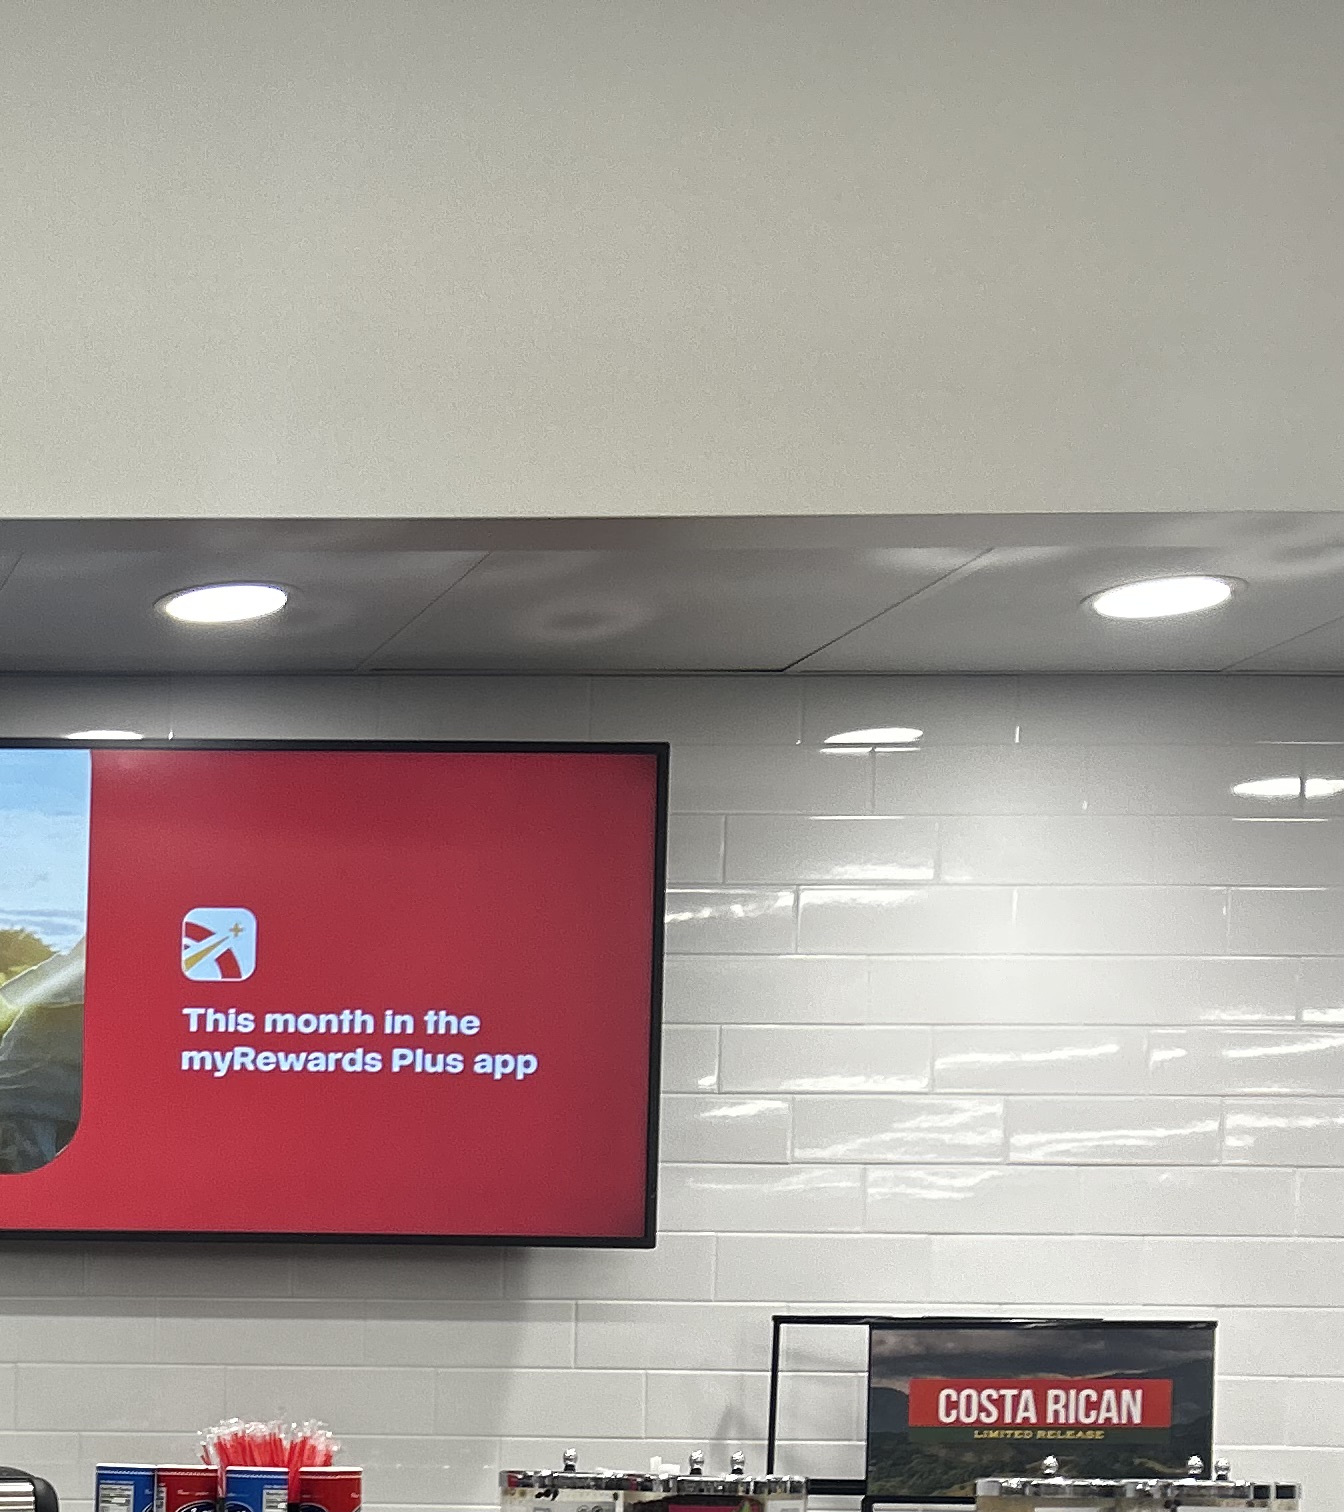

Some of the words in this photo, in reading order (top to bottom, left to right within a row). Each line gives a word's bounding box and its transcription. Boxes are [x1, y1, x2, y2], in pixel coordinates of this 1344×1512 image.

[182, 1007, 255, 1034] This
[265, 1008, 374, 1035] month
[384, 1009, 414, 1035] in
[424, 1009, 481, 1036] the
[181, 1045, 382, 1078] myRewards
[392, 1047, 464, 1074] Plus
[473, 1052, 538, 1080] app
[938, 1388, 1038, 1424] COSTA
[1046, 1388, 1143, 1424] RICAN
[974, 1430, 1033, 1439] LIMITED
[1036, 1430, 1105, 1439] RELEASE
